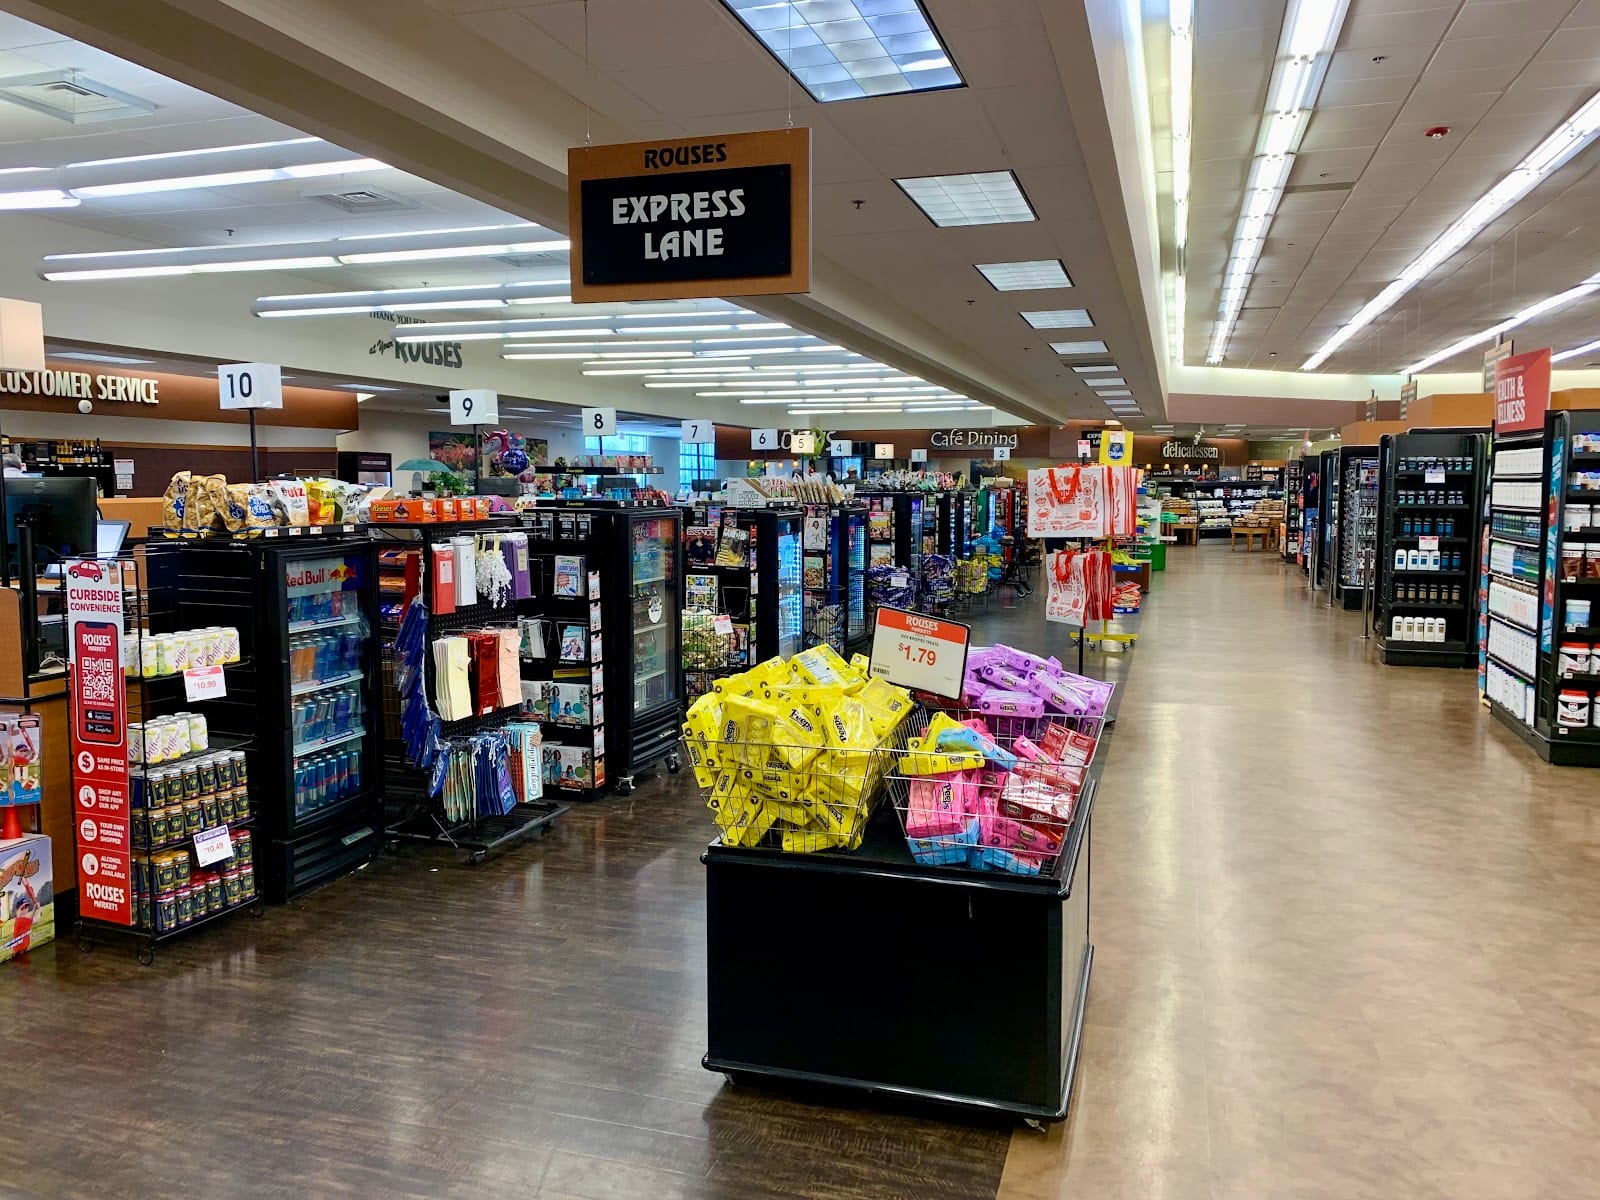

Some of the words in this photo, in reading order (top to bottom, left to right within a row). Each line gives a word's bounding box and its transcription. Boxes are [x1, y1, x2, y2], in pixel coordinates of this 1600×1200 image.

[644, 142, 727, 170] ROUSES
[612, 188, 746, 224] EXPRESS
[644, 228, 724, 262] LANE
[369, 310, 394, 322] THANK
[397, 314, 412, 324] YOU
[394, 340, 462, 368] ROUSES
[96, 374, 160, 404] SERVICE
[226, 372, 252, 398] 10
[1517, 375, 1524, 398] &
[462, 397, 474, 418] 9
[1498, 399, 1525, 424] ELLNESS
[594, 413, 604, 430] 8
[691, 425, 699, 439] 7
[759, 432, 766, 445] 6
[931, 428, 962, 446] Café
[968, 431, 1017, 449] Dining
[798, 438, 804, 448] 5
[836, 443, 842, 452] 4
[881, 447, 886, 456] 3
[286, 571, 304, 587] Red
[305, 568, 325, 584] Bull
[70, 588, 120, 602] CURBSIDE
[70, 602, 120, 613] CONVENIENCE
[906, 615, 939, 631] ROUSES
[82, 634, 111, 646] ROUSES
[898, 642, 936, 666] $1.79
[788, 708, 814, 732] Peeps
[86, 882, 124, 903] ROUSES
[94, 900, 118, 911] MARKETS
